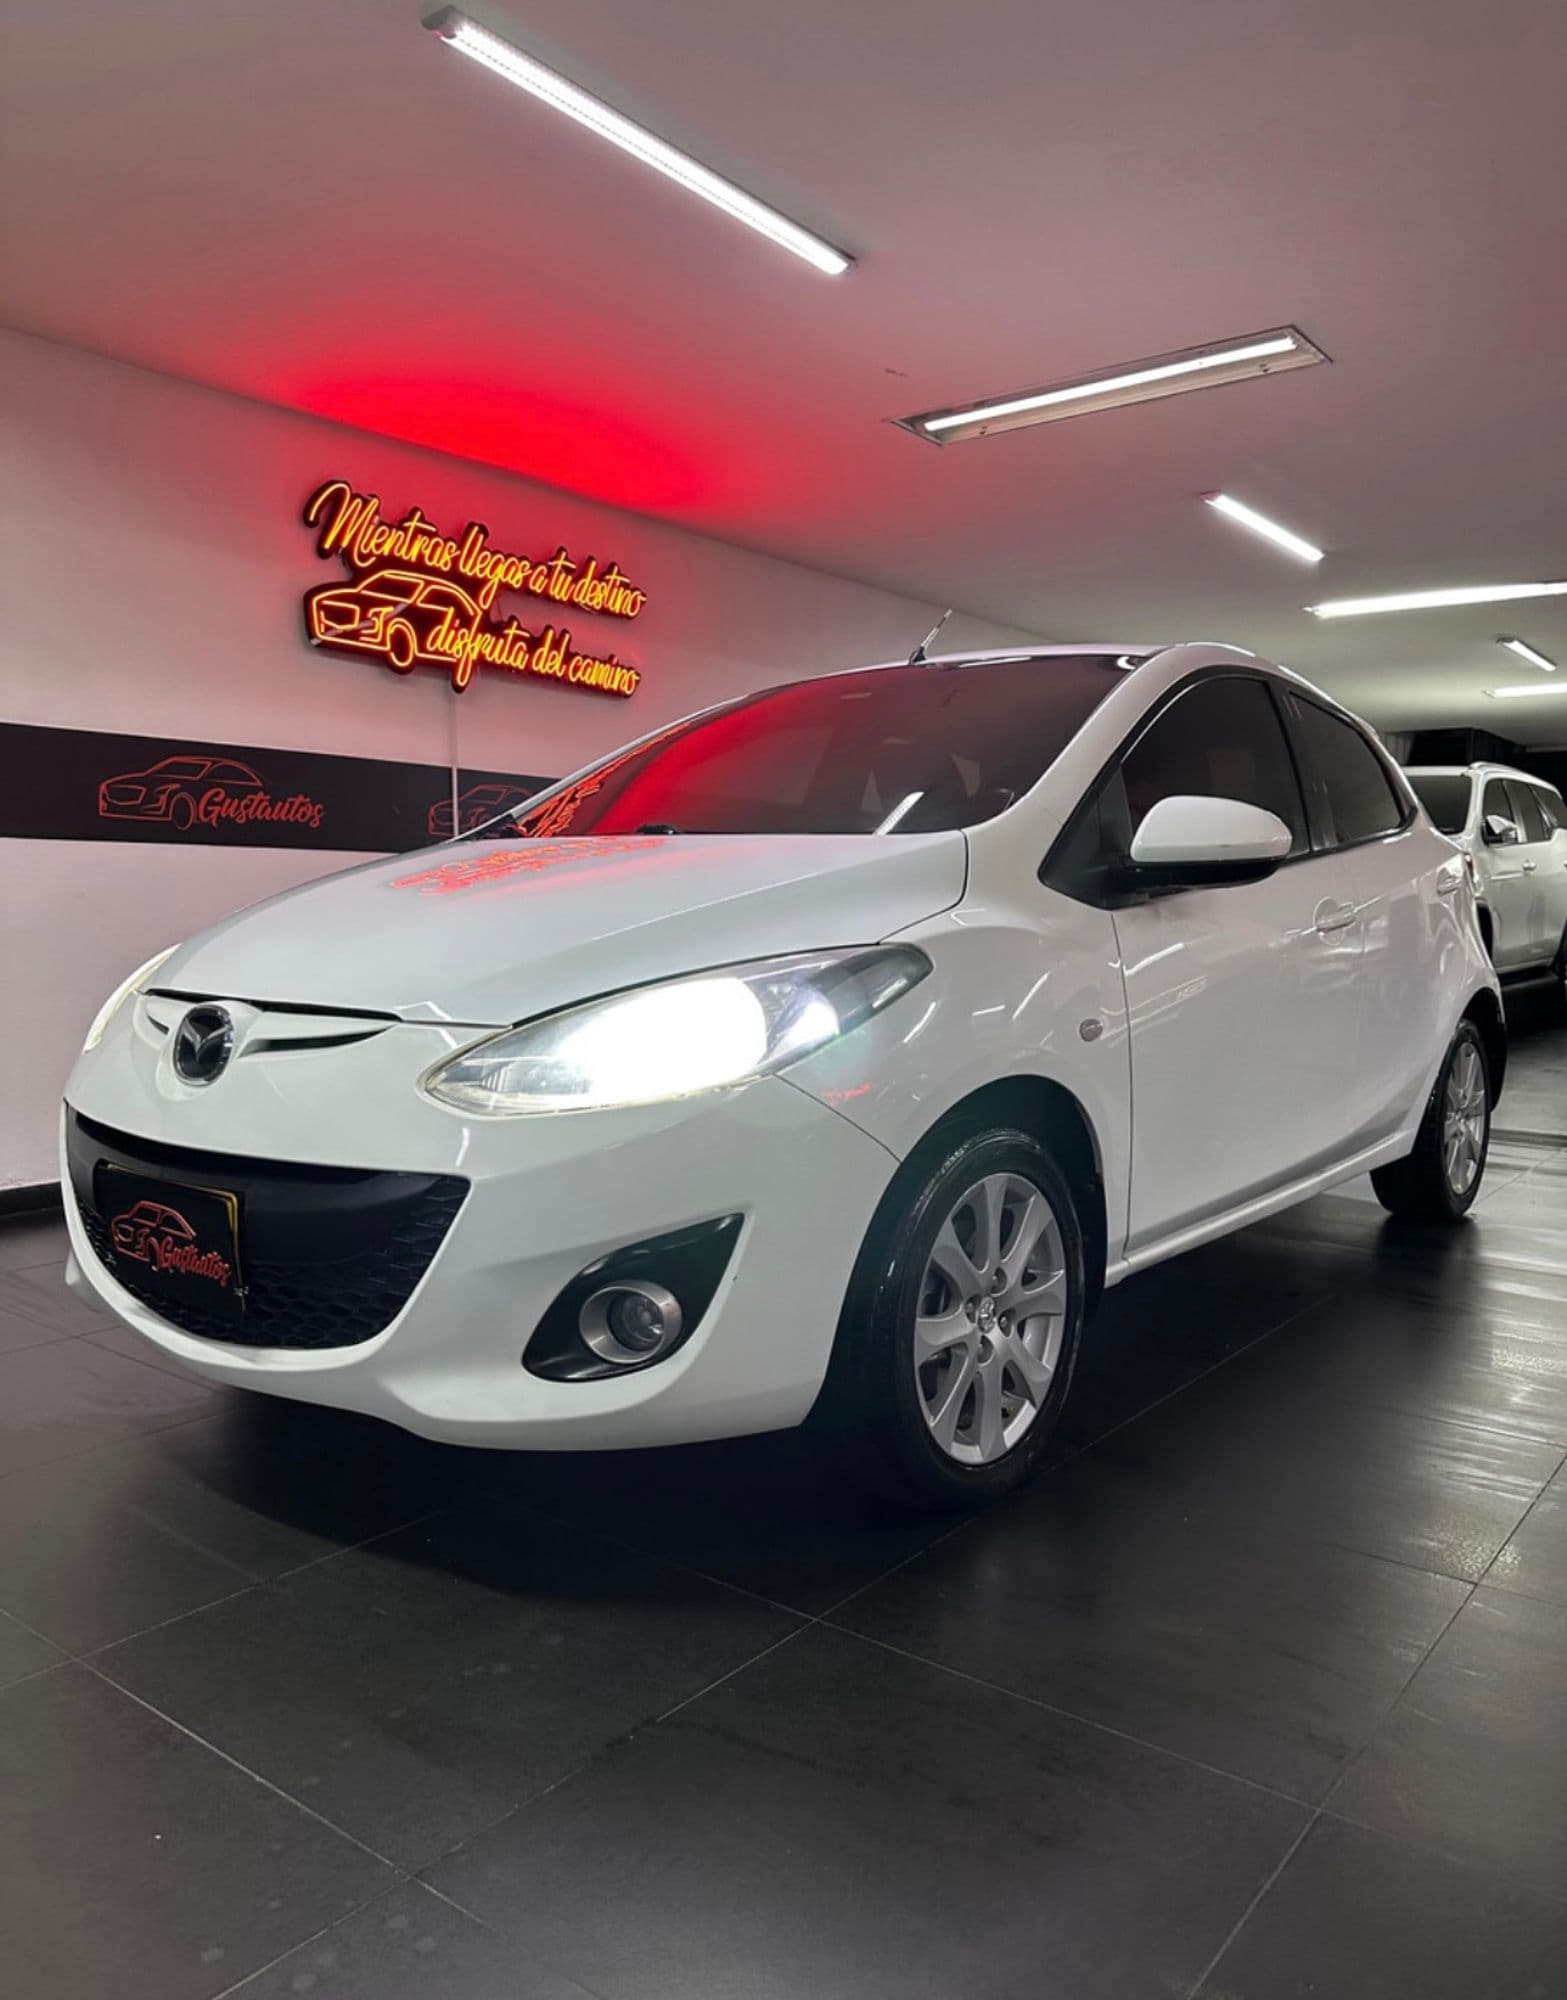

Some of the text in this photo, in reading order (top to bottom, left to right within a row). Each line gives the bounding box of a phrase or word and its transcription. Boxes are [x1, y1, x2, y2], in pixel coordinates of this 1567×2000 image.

[308, 483, 648, 617] Mientras llegas a tu destino
[426, 607, 640, 696] disfruta del camino
[199, 786, 326, 829] Gustautos
